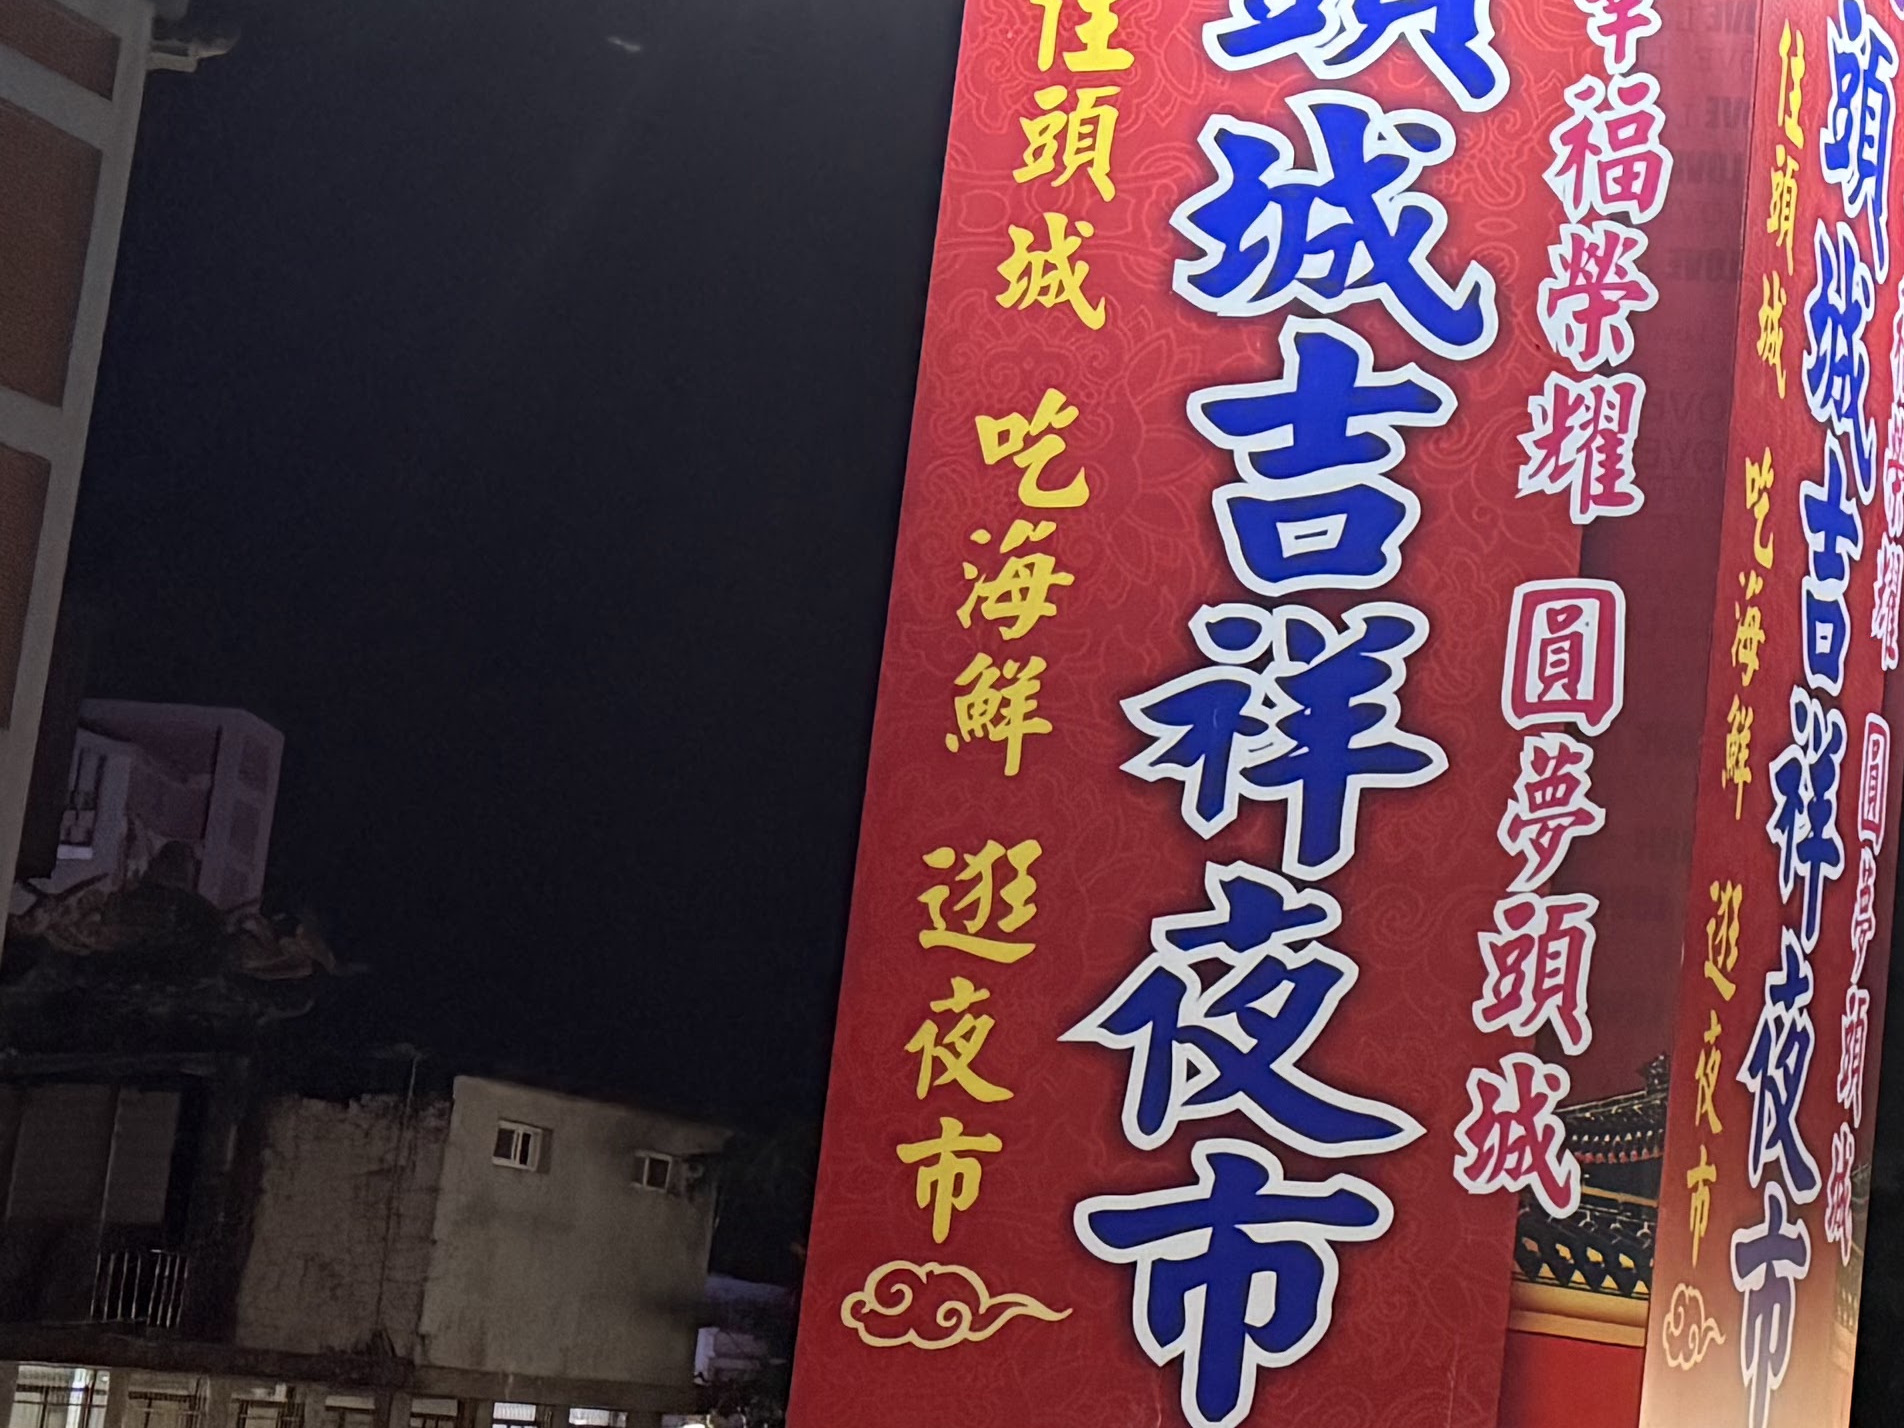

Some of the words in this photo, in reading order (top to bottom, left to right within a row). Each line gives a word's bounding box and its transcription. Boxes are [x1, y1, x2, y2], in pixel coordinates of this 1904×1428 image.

[945, 389, 1091, 776] 吃海鮮
[897, 837, 1045, 1245] 逛夜市
[1454, 578, 1625, 1221] 圓夢頭城
